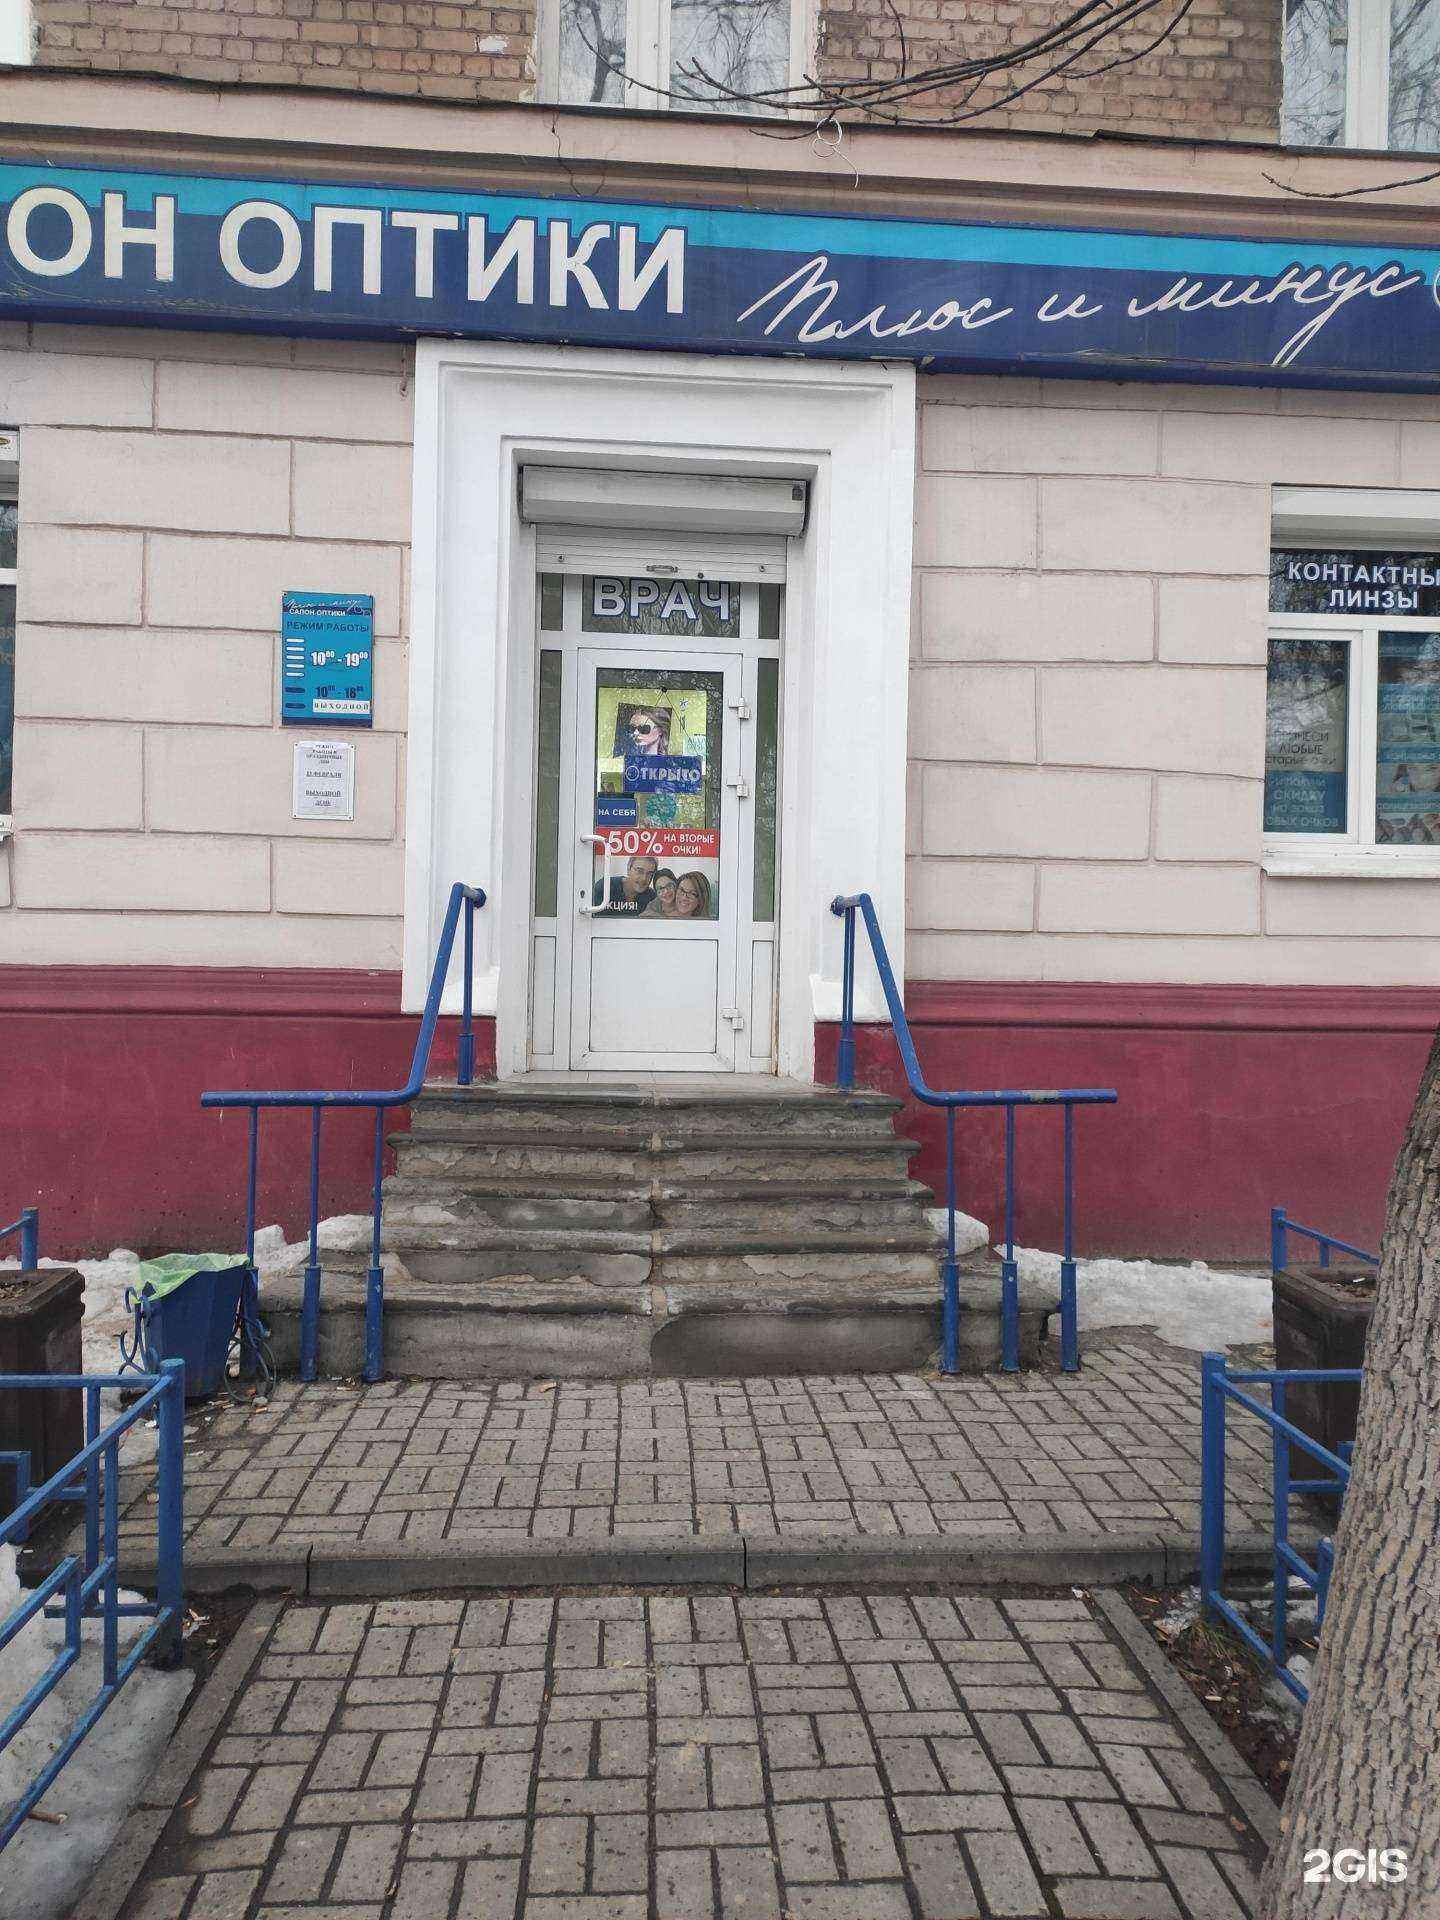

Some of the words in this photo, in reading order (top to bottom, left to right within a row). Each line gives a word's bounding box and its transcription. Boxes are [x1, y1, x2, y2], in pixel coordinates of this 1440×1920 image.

[218, 201, 687, 315] ОПТИКИ
[738, 255, 1013, 342] Плюс
[1037, 293, 1103, 321] и
[1127, 261, 1421, 367] минус
[592, 577, 731, 621] ВРАЧ
[1329, 589, 1419, 610] ЛИНЗЫ
[289, 607, 315, 616] САЛОН
[316, 609, 346, 617] ОПТИКИ
[286, 621, 324, 631] РЕЖИМ
[326, 622, 370, 633] РАБОТЫ
[1279, 743, 1323, 755] ЛЮБЫЕ
[598, 808, 610, 816] НА
[612, 808, 636, 817] СЕБЯ
[663, 834, 677, 843] НА
[679, 834, 715, 844] ВТОРЫЕ
[672, 845, 701, 855] ОЧКИ!
[603, 901, 638, 911] КЦИЯ!
